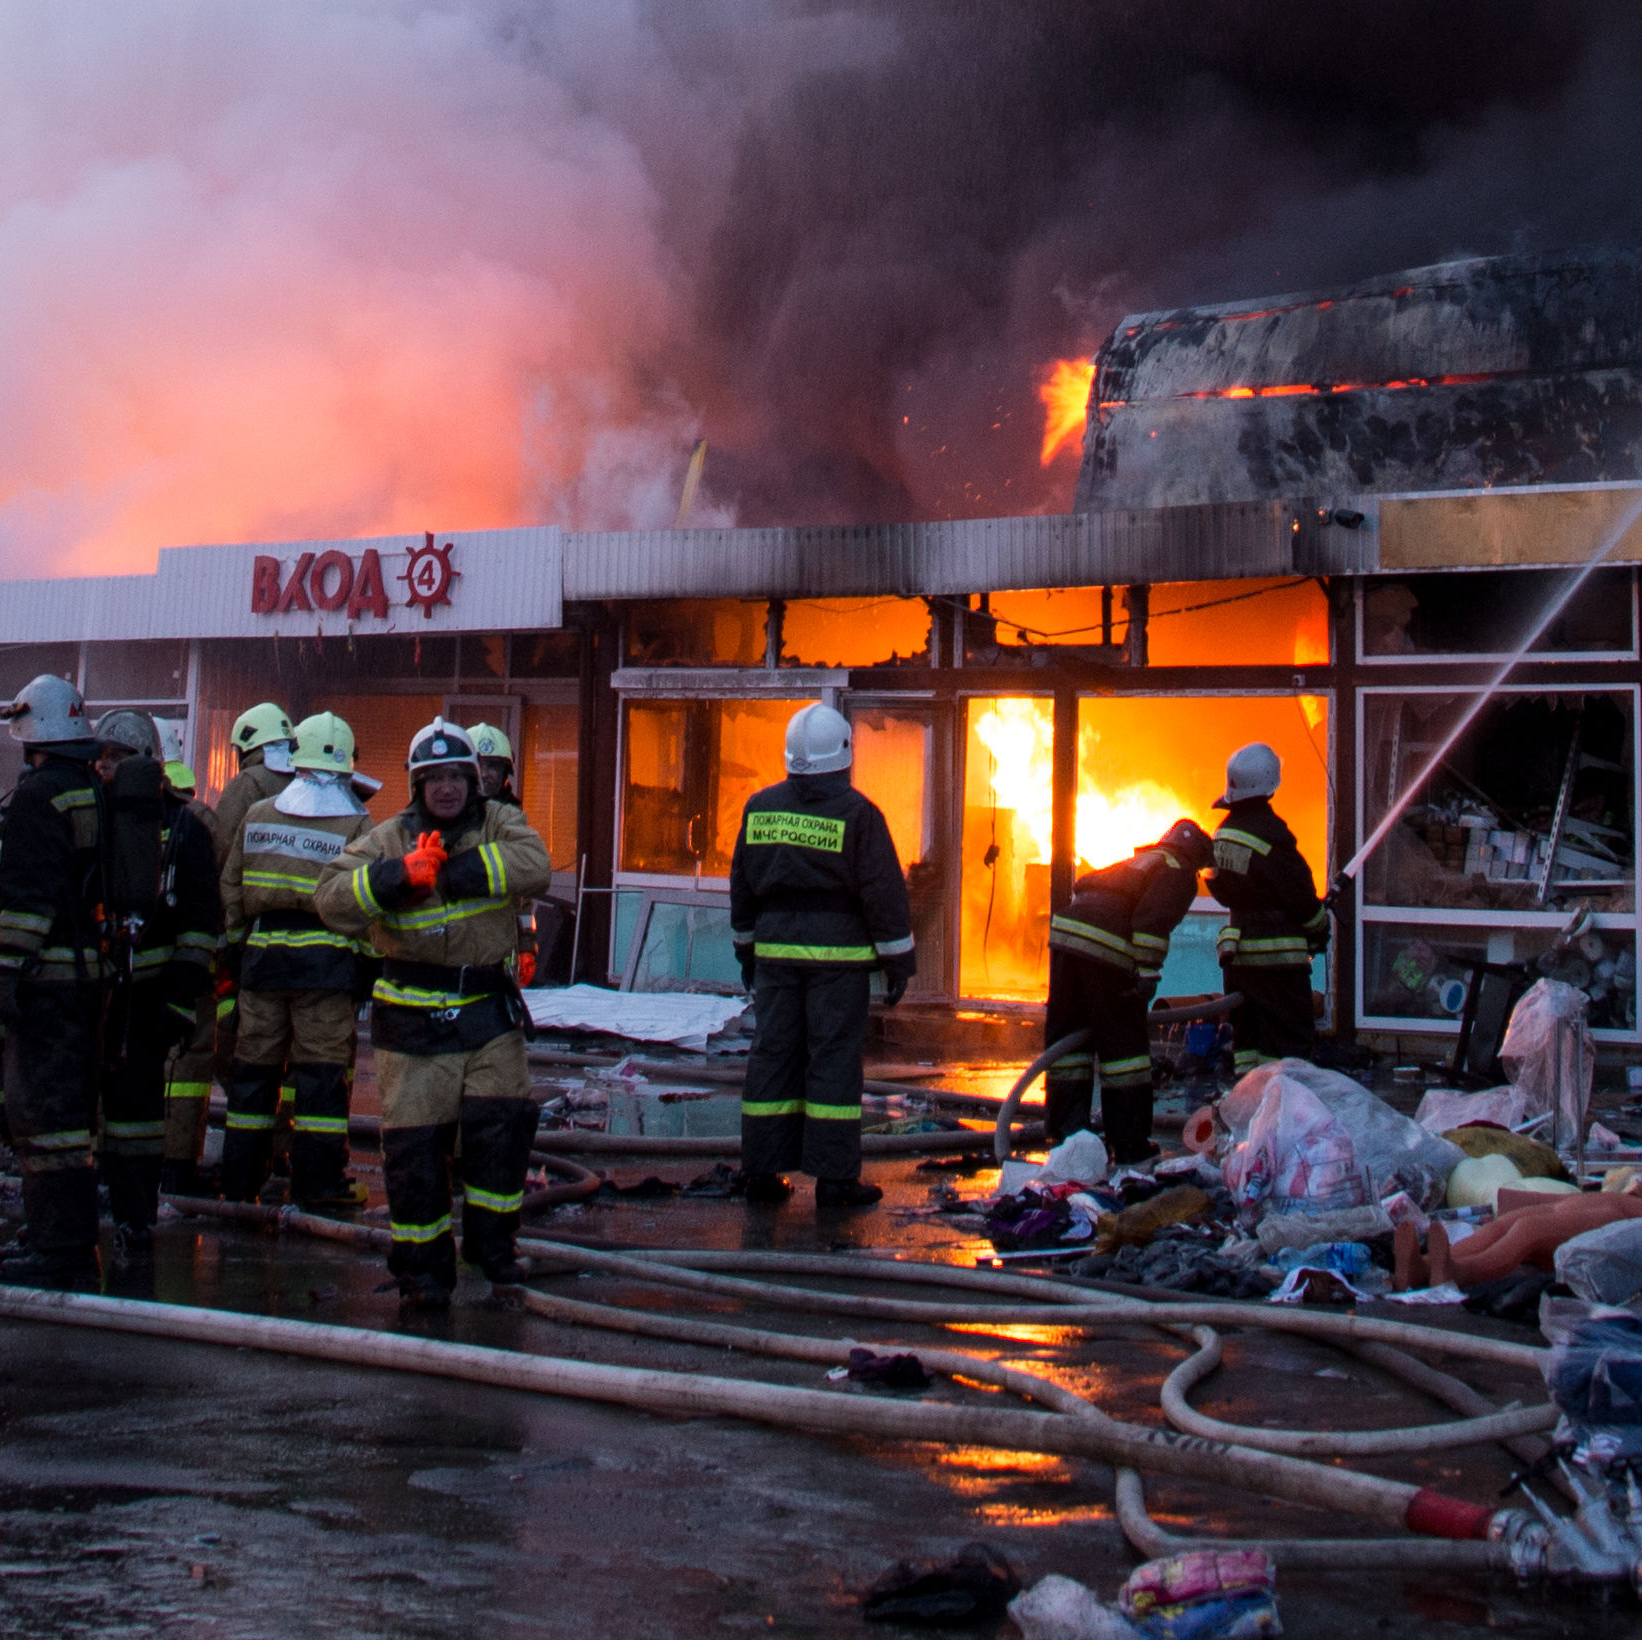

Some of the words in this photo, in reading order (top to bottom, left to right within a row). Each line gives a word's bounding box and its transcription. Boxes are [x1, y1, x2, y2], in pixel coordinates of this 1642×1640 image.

[251, 548, 389, 620] ВХОД
[417, 559, 436, 591] 4
[752, 814, 800, 827] ПОЖАРНАЯ
[801, 818, 839, 834] ОХРАНА
[246, 831, 297, 847] ПОЖАРНАЯ
[302, 838, 342, 855] ОХРАНА
[752, 829, 778, 841] МЧС
[780, 829, 838, 849] РОССИИ
